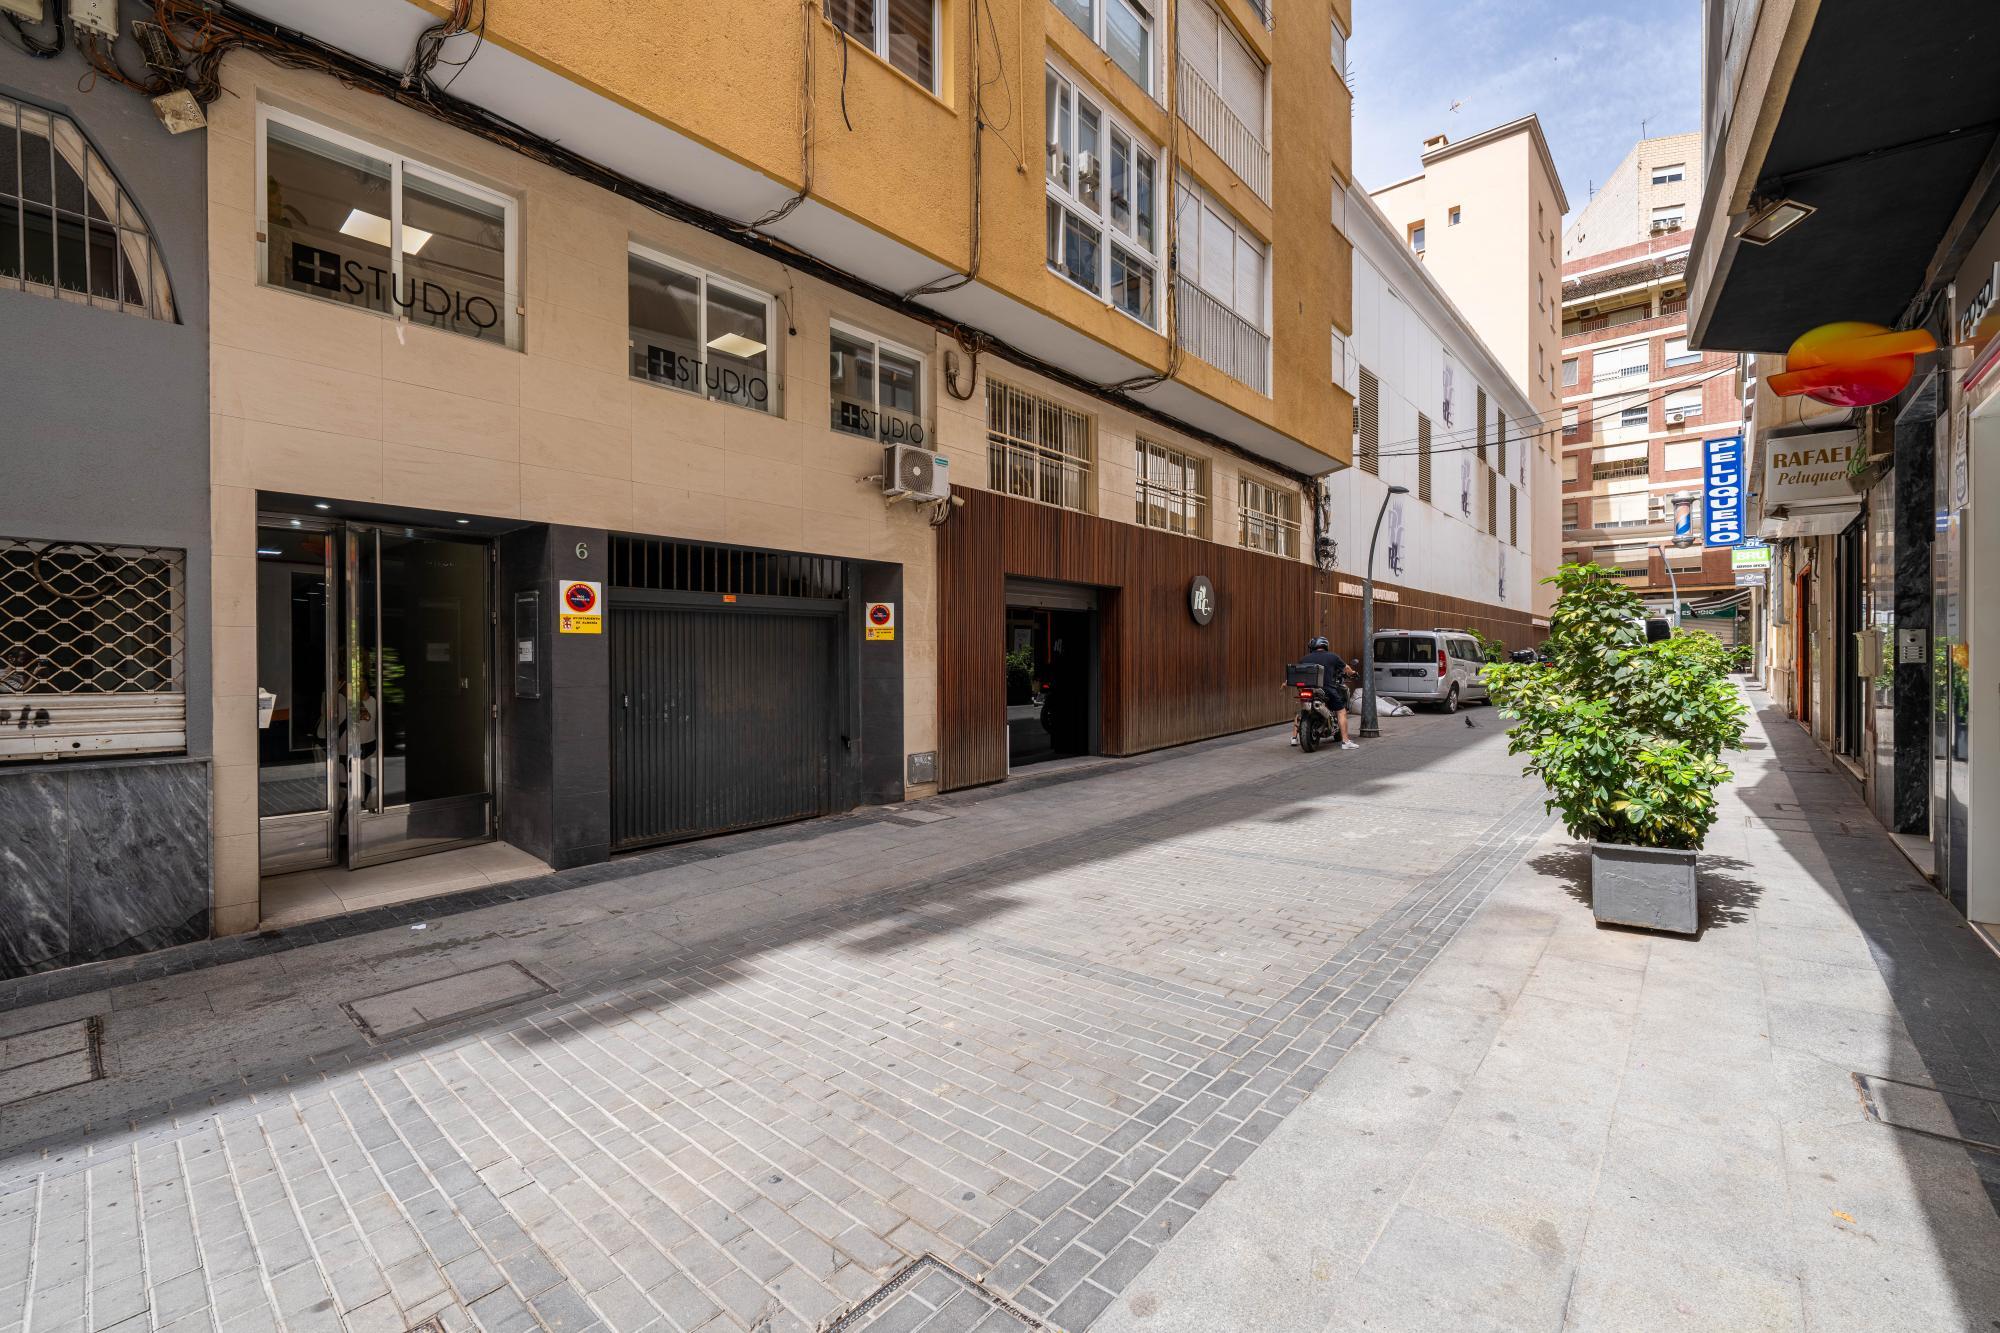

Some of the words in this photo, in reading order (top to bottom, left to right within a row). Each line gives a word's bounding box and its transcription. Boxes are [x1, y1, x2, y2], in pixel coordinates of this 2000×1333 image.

[1773, 446, 1852, 469] RAFAEL
[1708, 440, 1740, 543] PELUQUERO
[576, 542, 588, 560] 6
